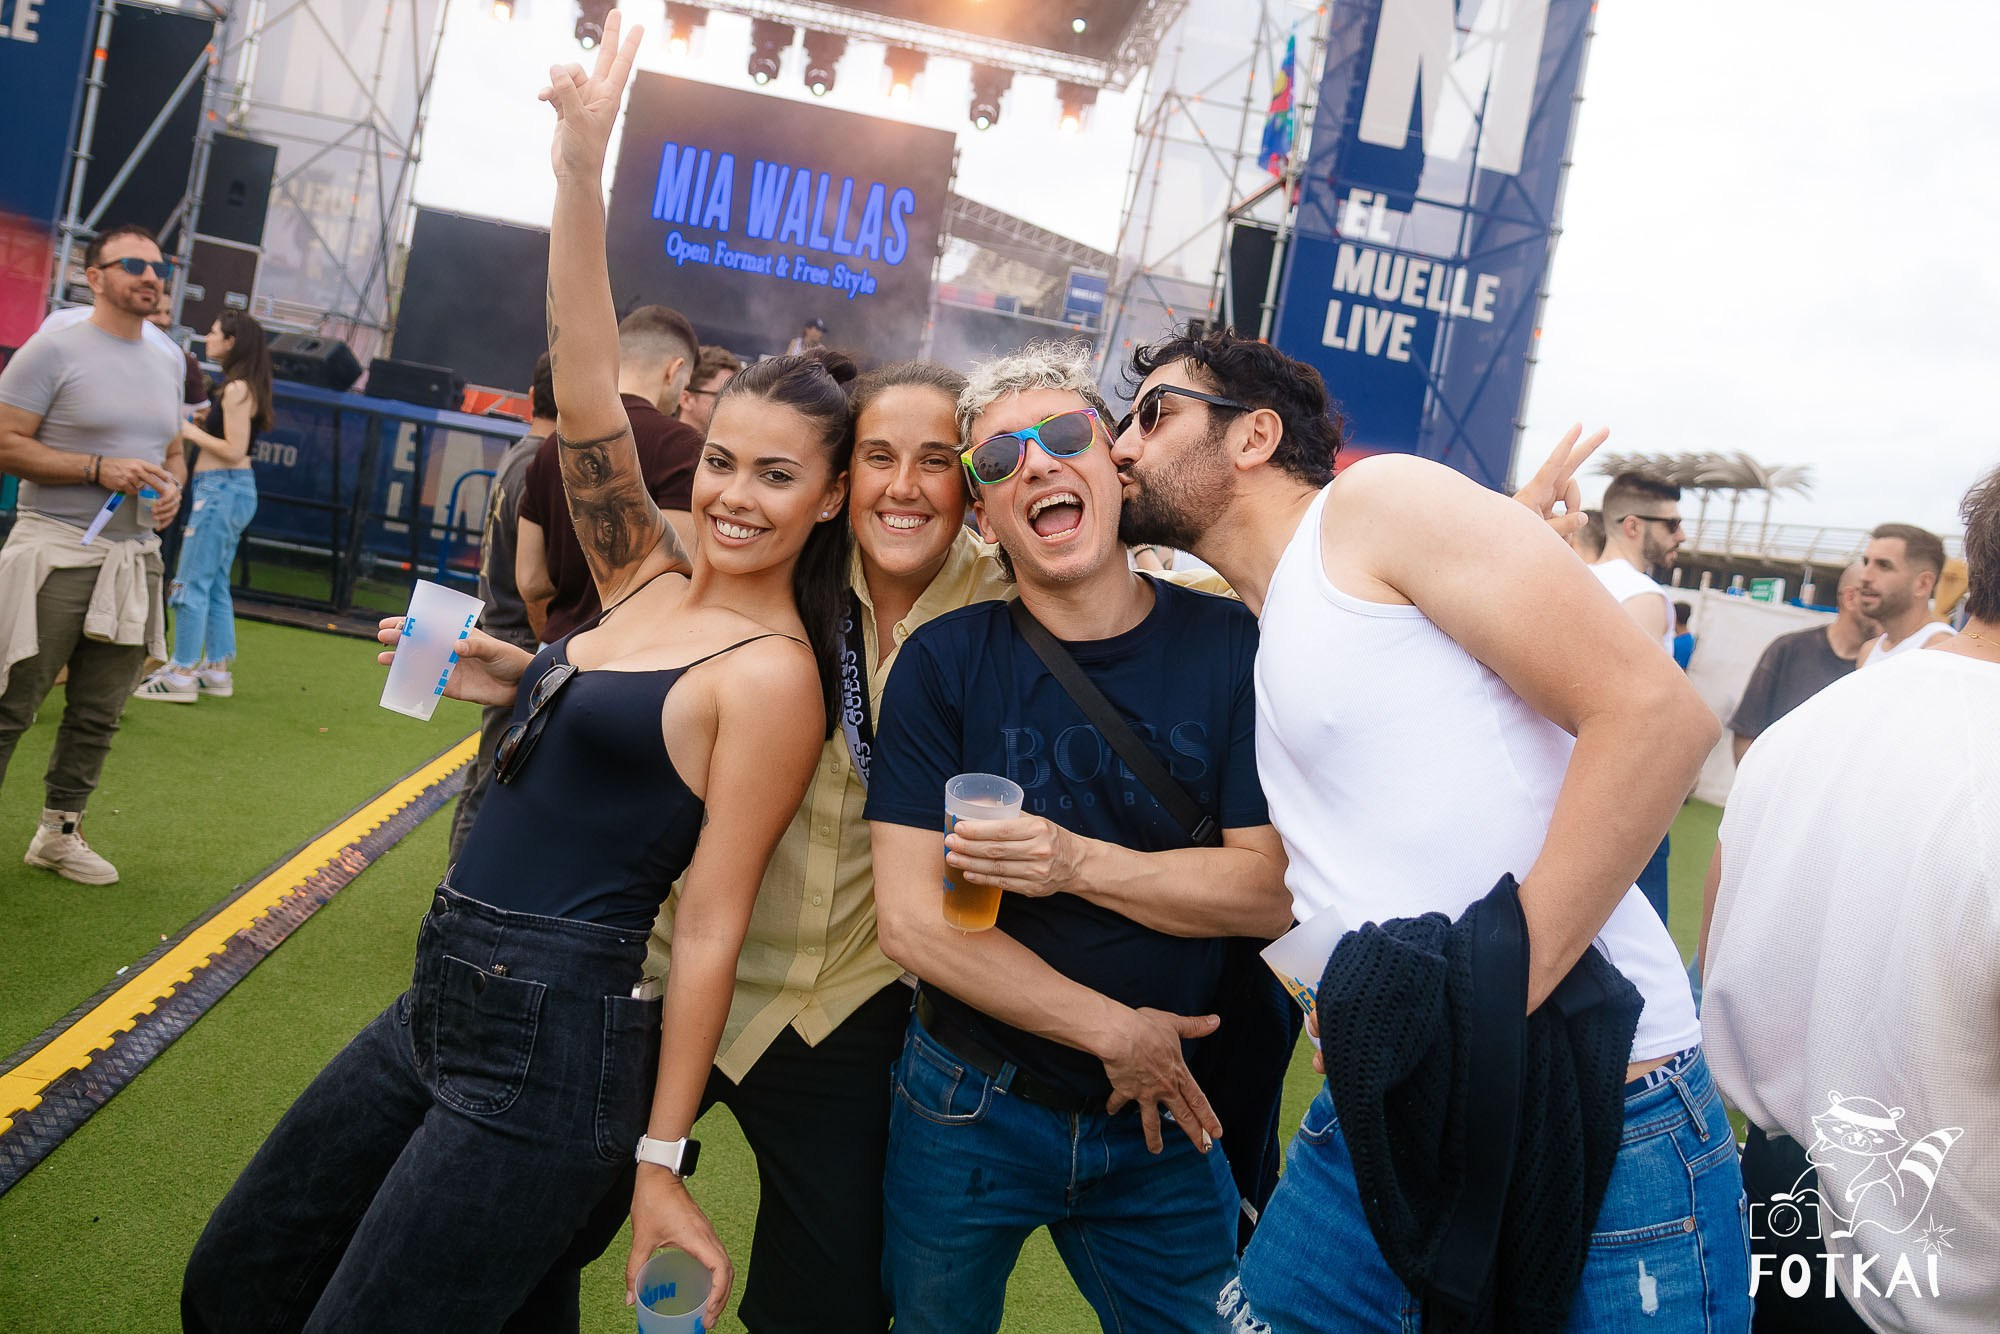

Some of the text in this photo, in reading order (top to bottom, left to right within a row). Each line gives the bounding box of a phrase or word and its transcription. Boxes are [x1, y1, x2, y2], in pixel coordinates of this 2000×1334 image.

[652, 141, 915, 266] MIA WALLAS
[1342, 187, 1392, 244] EL
[666, 230, 877, 300] Open Format & Free Style
[1332, 244, 1501, 323] MUELLE
[1322, 299, 1417, 363] LIVE
[841, 650, 864, 727] GUESS
